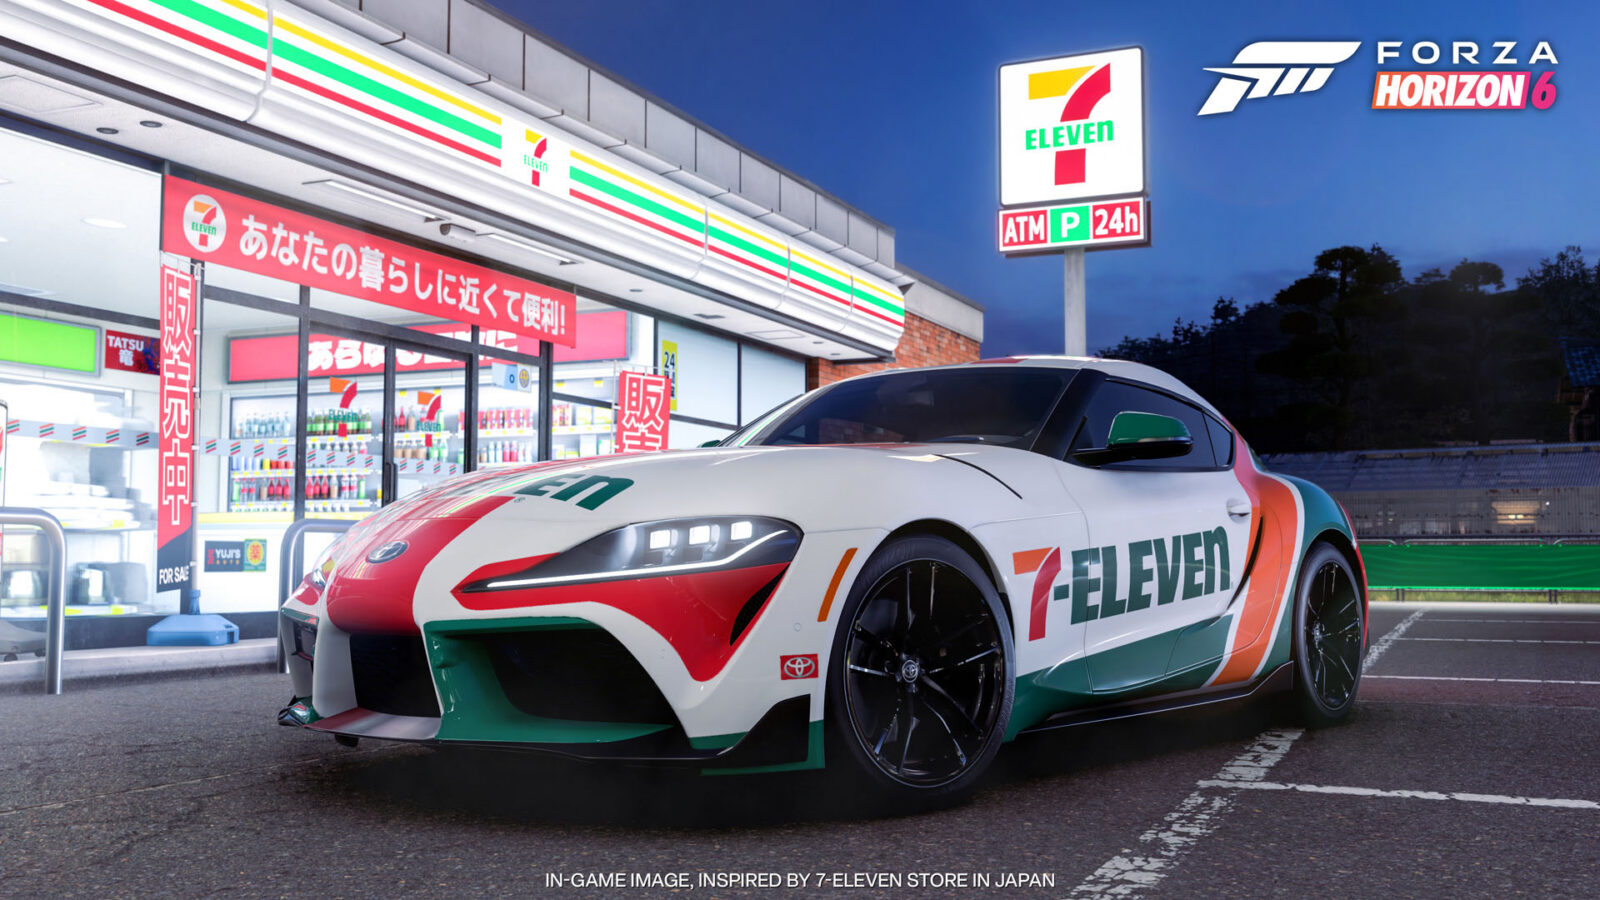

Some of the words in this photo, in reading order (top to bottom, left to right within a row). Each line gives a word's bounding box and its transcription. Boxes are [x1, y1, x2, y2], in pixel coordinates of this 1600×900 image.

[1004, 214, 1045, 245] ATM
[1061, 212, 1081, 238] P
[1095, 206, 1138, 236] 24h
[107, 335, 144, 351] TATSU
[664, 351, 676, 369] 24
[162, 267, 192, 525] 販売中
[215, 548, 241, 559] YUJI'S
[159, 567, 174, 584] FOR
